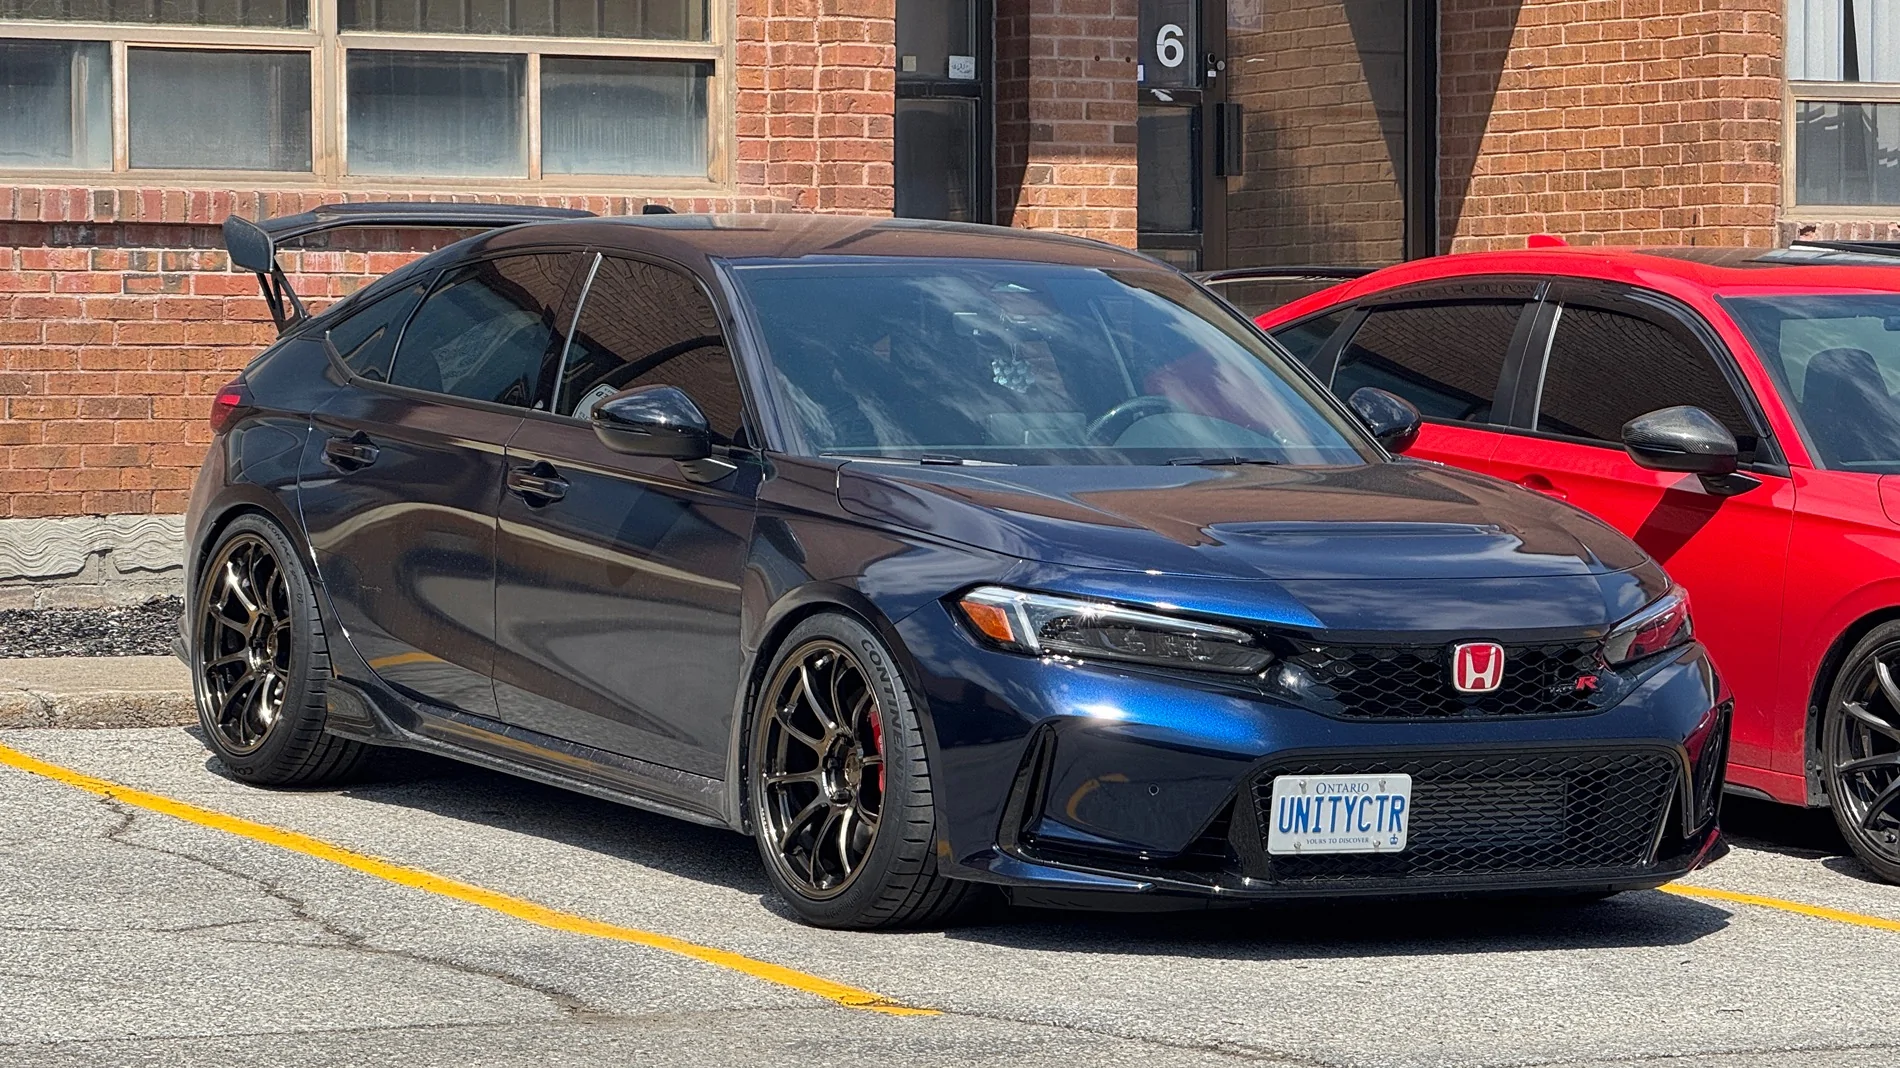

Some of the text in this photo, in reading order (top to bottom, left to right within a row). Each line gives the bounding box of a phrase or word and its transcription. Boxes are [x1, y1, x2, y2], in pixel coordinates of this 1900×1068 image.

[1156, 23, 1185, 68] 6
[1576, 675, 1598, 690] R
[1316, 782, 1370, 795] ONTARIO
[1278, 795, 1406, 834] UNITYCTR
